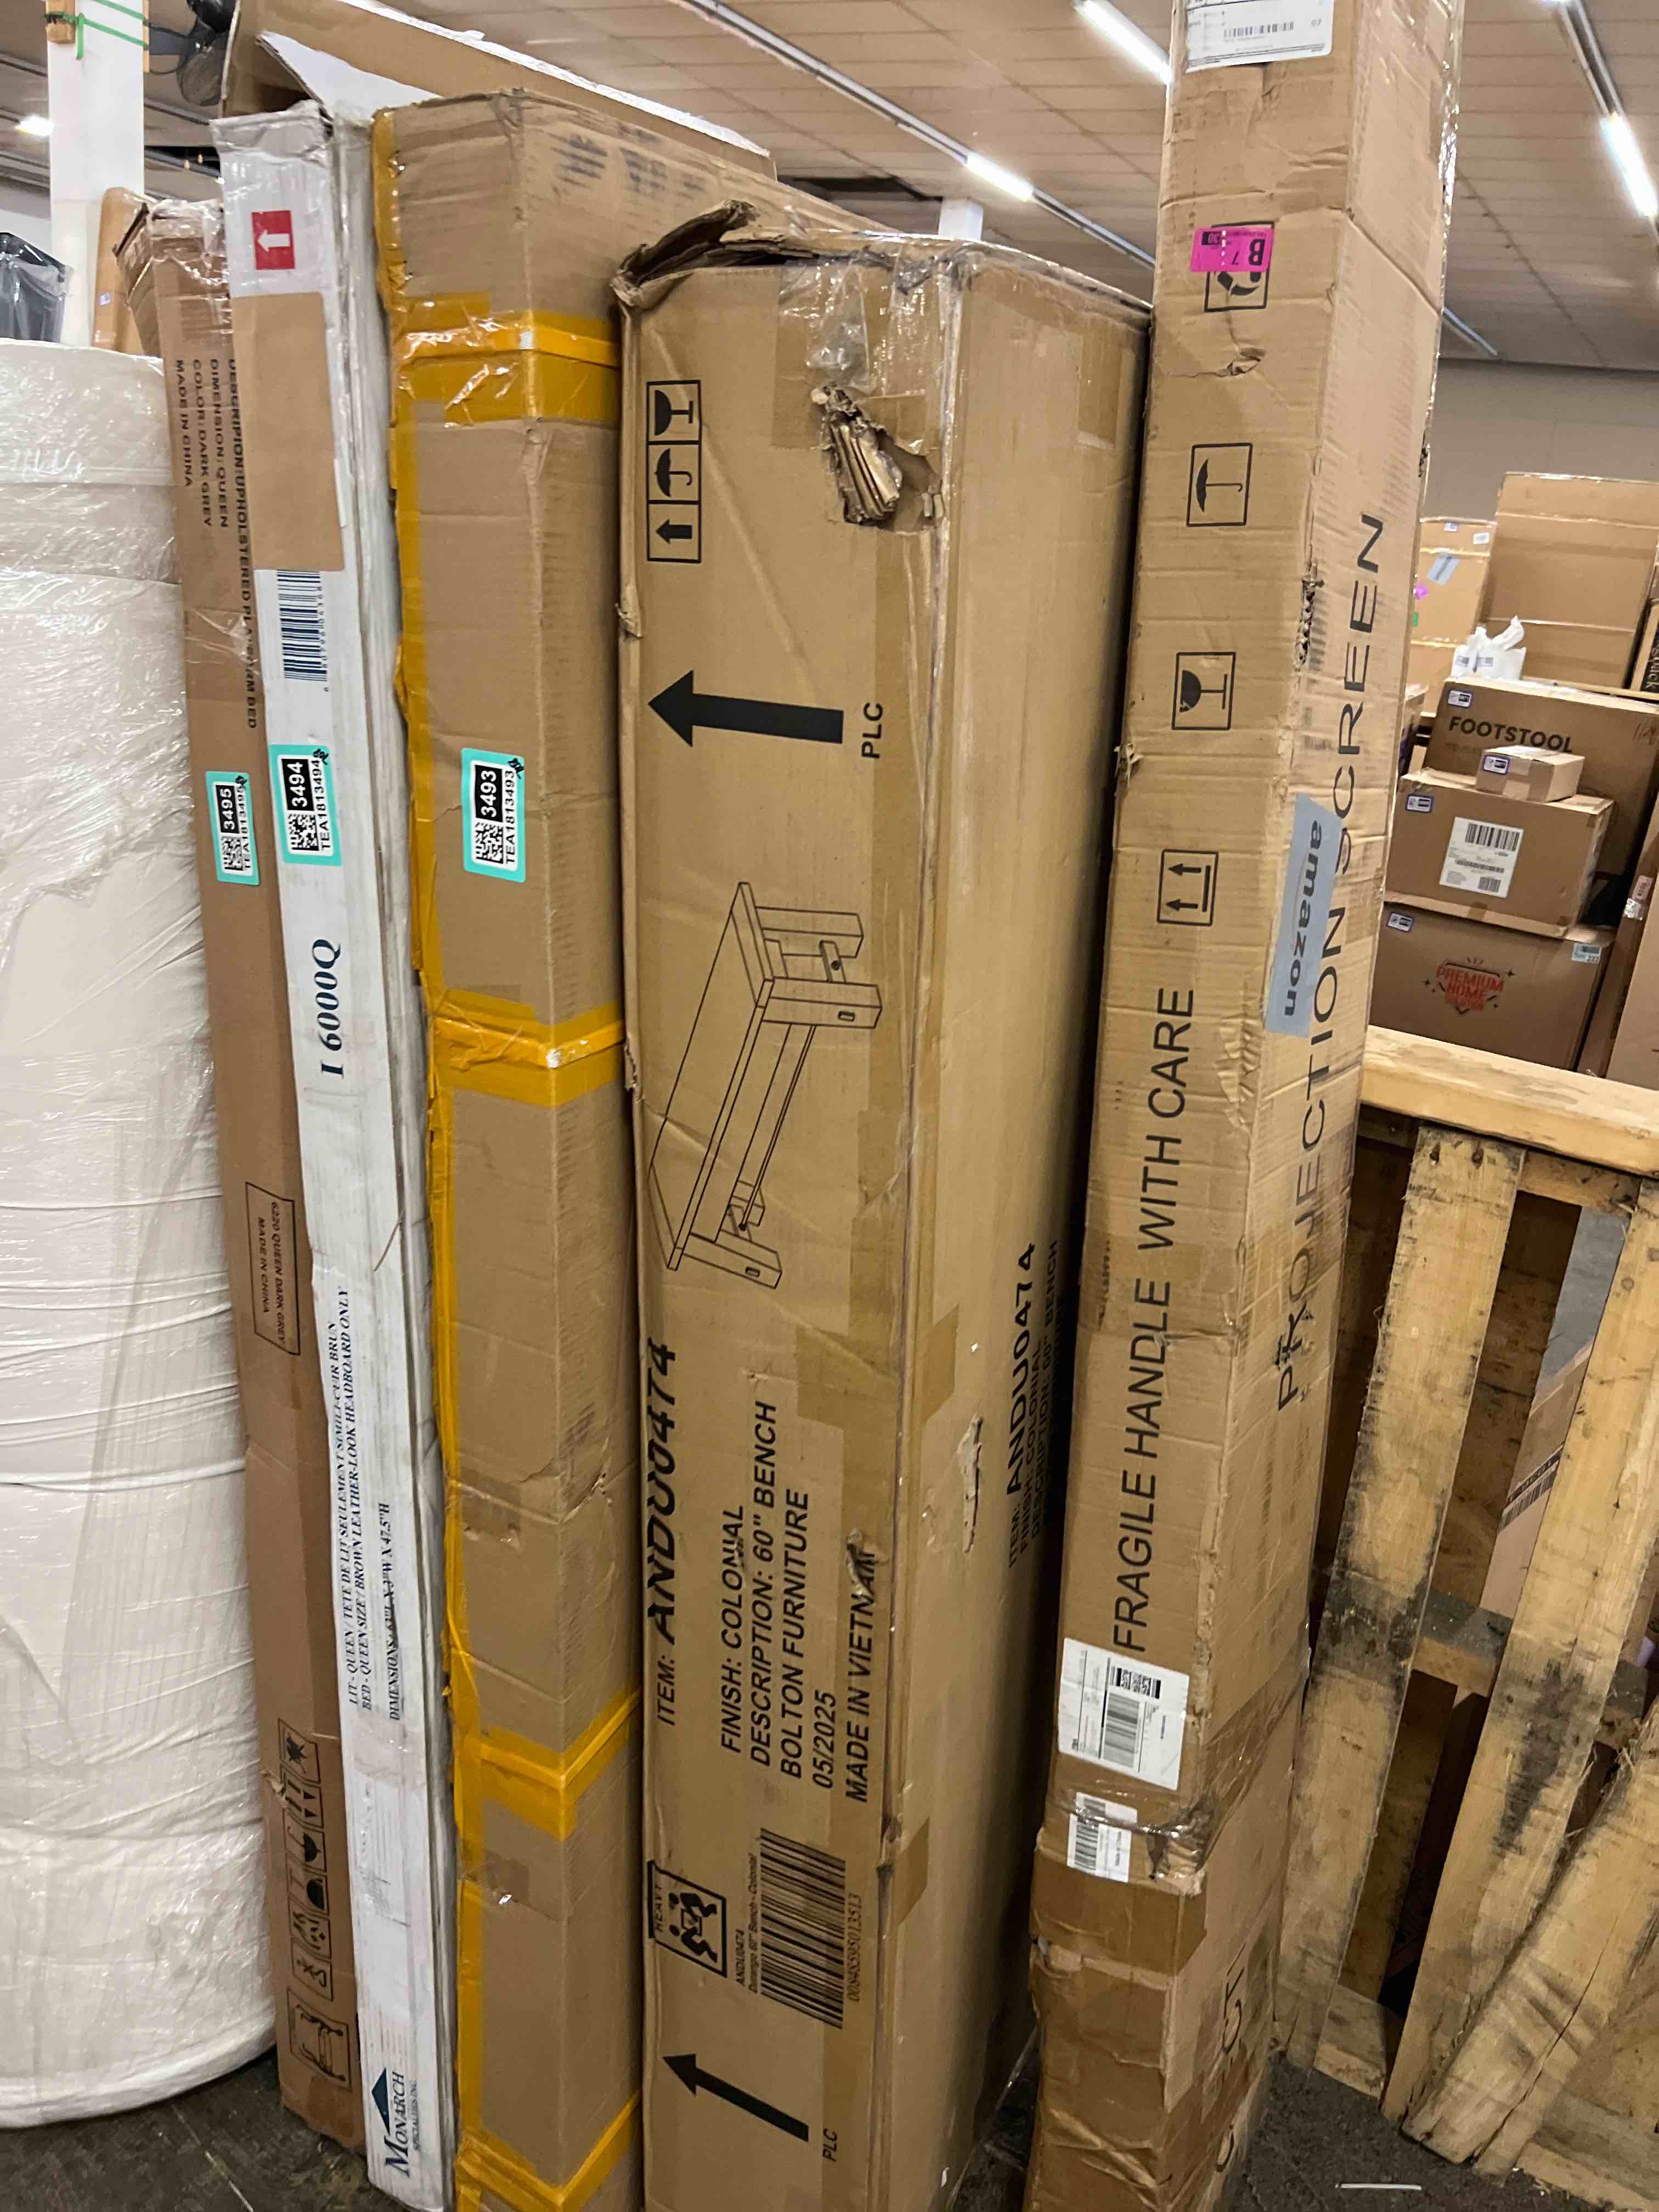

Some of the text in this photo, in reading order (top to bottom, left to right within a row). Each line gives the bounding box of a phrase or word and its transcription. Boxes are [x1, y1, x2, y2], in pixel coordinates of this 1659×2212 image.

[176, 360, 193, 487] MADE IN CHINA
[201, 482, 211, 526] GREY
[216, 466, 229, 527] QUEEN
[247, 696, 257, 729] BED
[861, 702, 883, 759] PLC
[1448, 716, 1572, 753] FOOTSTOOL
[220, 788, 235, 830] 3495
[287, 762, 308, 808] 3494
[311, 760, 331, 851] TEA1813494
[480, 770, 496, 818] 3493
[236, 786, 250, 871] TEA1813495
[505, 770, 515, 865] TEA1813493
[1284, 820, 1322, 1017] amazon
[311, 938, 343, 1051] 6000Q
[1436, 965, 1504, 992] PREMIUM
[1147, 987, 1194, 1120] CARE
[1278, 907, 1345, 1410] PROJECTION
[1136, 1135, 1182, 1251] WITH
[258, 1217, 270, 1313] MADE IN CHINA
[272, 1233, 283, 1274] QUEEN
[275, 1278, 284, 1308] DARK
[337, 1286, 350, 1329] ONLY
[276, 1312, 286, 1343] GREY
[327, 1321, 340, 1362] BRUN
[341, 1331, 356, 1423] HEADBOARD
[1006, 1243, 1035, 1495] ANDU0474
[1123, 1278, 1171, 1459] HANDLE
[347, 1427, 362, 1537] LEATHER-LOOK
[339, 1538, 350, 1563] LIT
[646, 1338, 676, 1726] ITEM: ANDU0474
[340, 1566, 351, 1584] DE
[351, 1538, 365, 1590] BROWN
[750, 1400, 776, 1767] DESCRIPTION: 60" BENCH
[1114, 1470, 1156, 1653] FRAGILE
[355, 1598, 368, 1629] SIZE
[721, 1504, 744, 1753] FINISH: COLONIAL
[780, 1488, 809, 1778] BOLTON FURNITURE
[343, 1628, 358, 1673] QUEEN
[357, 1631, 371, 1675] QUEEN
[360, 1684, 372, 1711] BED
[847, 1686, 870, 1716] IN
[812, 1689, 836, 1790] 05/2025
[845, 1720, 868, 1803] MADE
[653, 1884, 663, 1933] HEAVY
[822, 2128, 837, 2162] PLC
